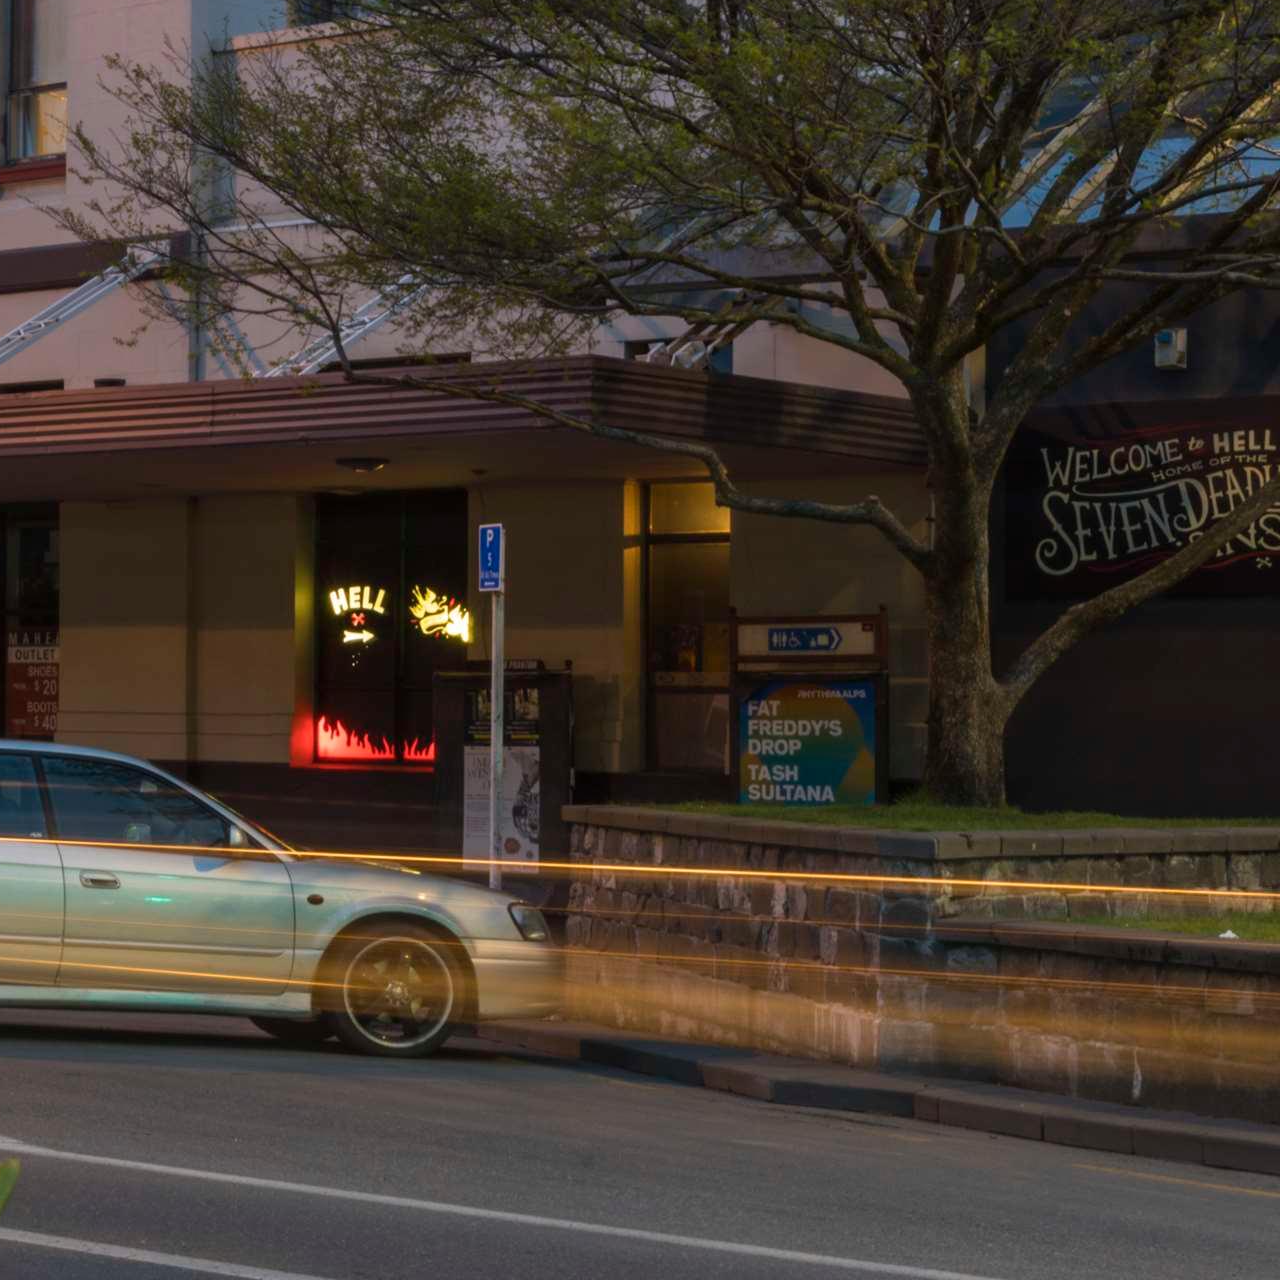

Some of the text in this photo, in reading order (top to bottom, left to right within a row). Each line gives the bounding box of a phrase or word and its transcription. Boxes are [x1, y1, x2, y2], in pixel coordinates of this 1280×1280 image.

[1041, 429, 1277, 488] WELCOME to HELL
[1151, 454, 1268, 482] HOME OF THE
[1035, 464, 1280, 576] SEVEN DEAD
[486, 529, 494, 548] P
[329, 586, 386, 615] HELL
[15, 649, 56, 661] OUTLET
[27, 665, 57, 677] SHOES
[26, 701, 57, 712] BOOTS
[747, 700, 780, 716] FAT
[747, 720, 842, 736] FREDDY'S
[747, 739, 802, 755] DROP
[747, 765, 799, 781] TASH
[748, 784, 835, 801] SULTANA
